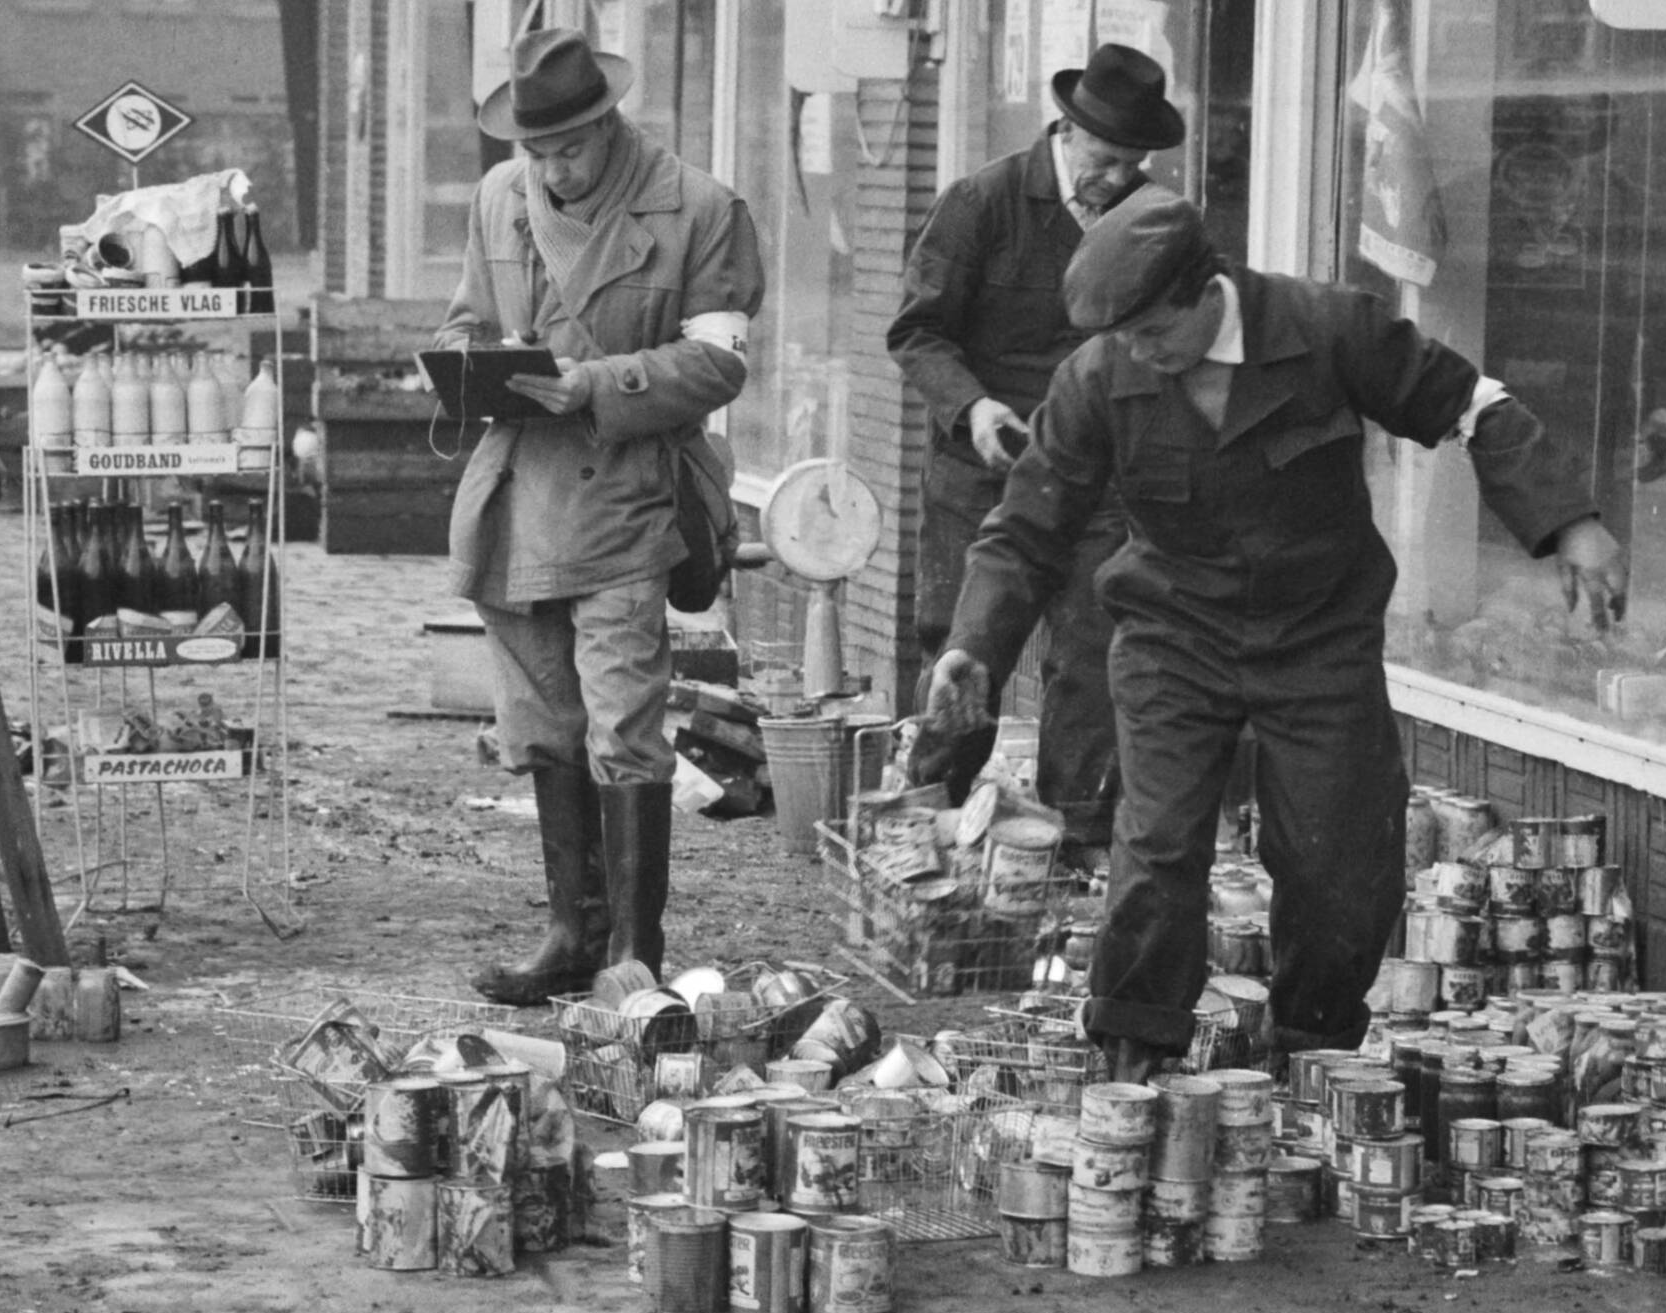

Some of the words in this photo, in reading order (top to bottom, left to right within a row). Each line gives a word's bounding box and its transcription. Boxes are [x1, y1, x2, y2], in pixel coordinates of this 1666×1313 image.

[89, 295, 170, 313] FRIESCHE
[181, 294, 222, 312] VLAG
[89, 453, 182, 470] GOUDBAND
[91, 641, 167, 661] RIVELLA
[98, 757, 227, 777] PASTACHOCA
